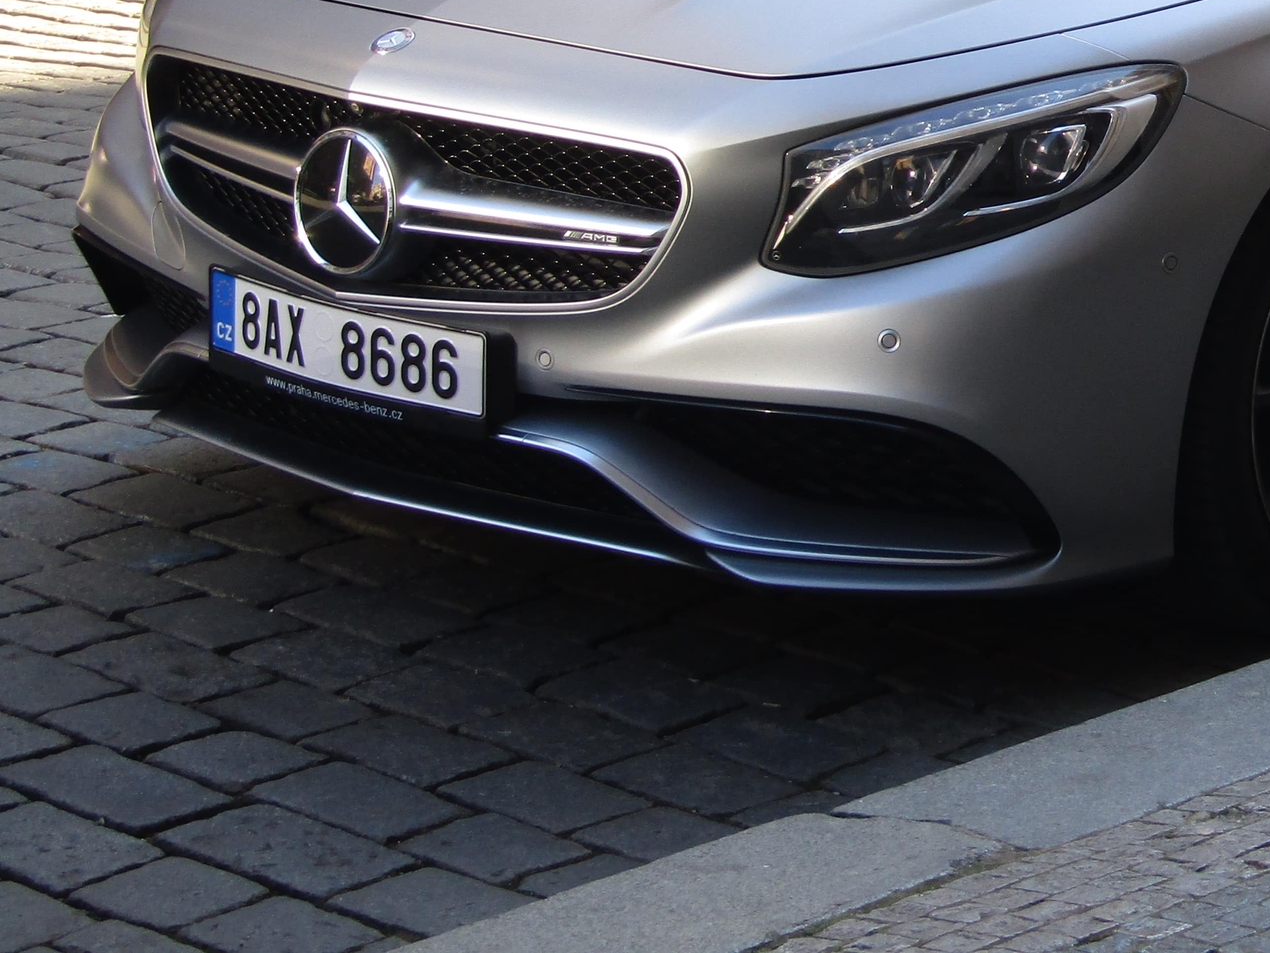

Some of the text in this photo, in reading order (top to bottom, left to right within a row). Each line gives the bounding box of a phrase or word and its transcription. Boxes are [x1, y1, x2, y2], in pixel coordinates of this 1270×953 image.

[580, 232, 618, 244] AMG
[216, 321, 234, 342] CZ
[242, 291, 458, 399] 8AX 8686
[265, 374, 404, 421] www.praha.mercedes-benz.cz
